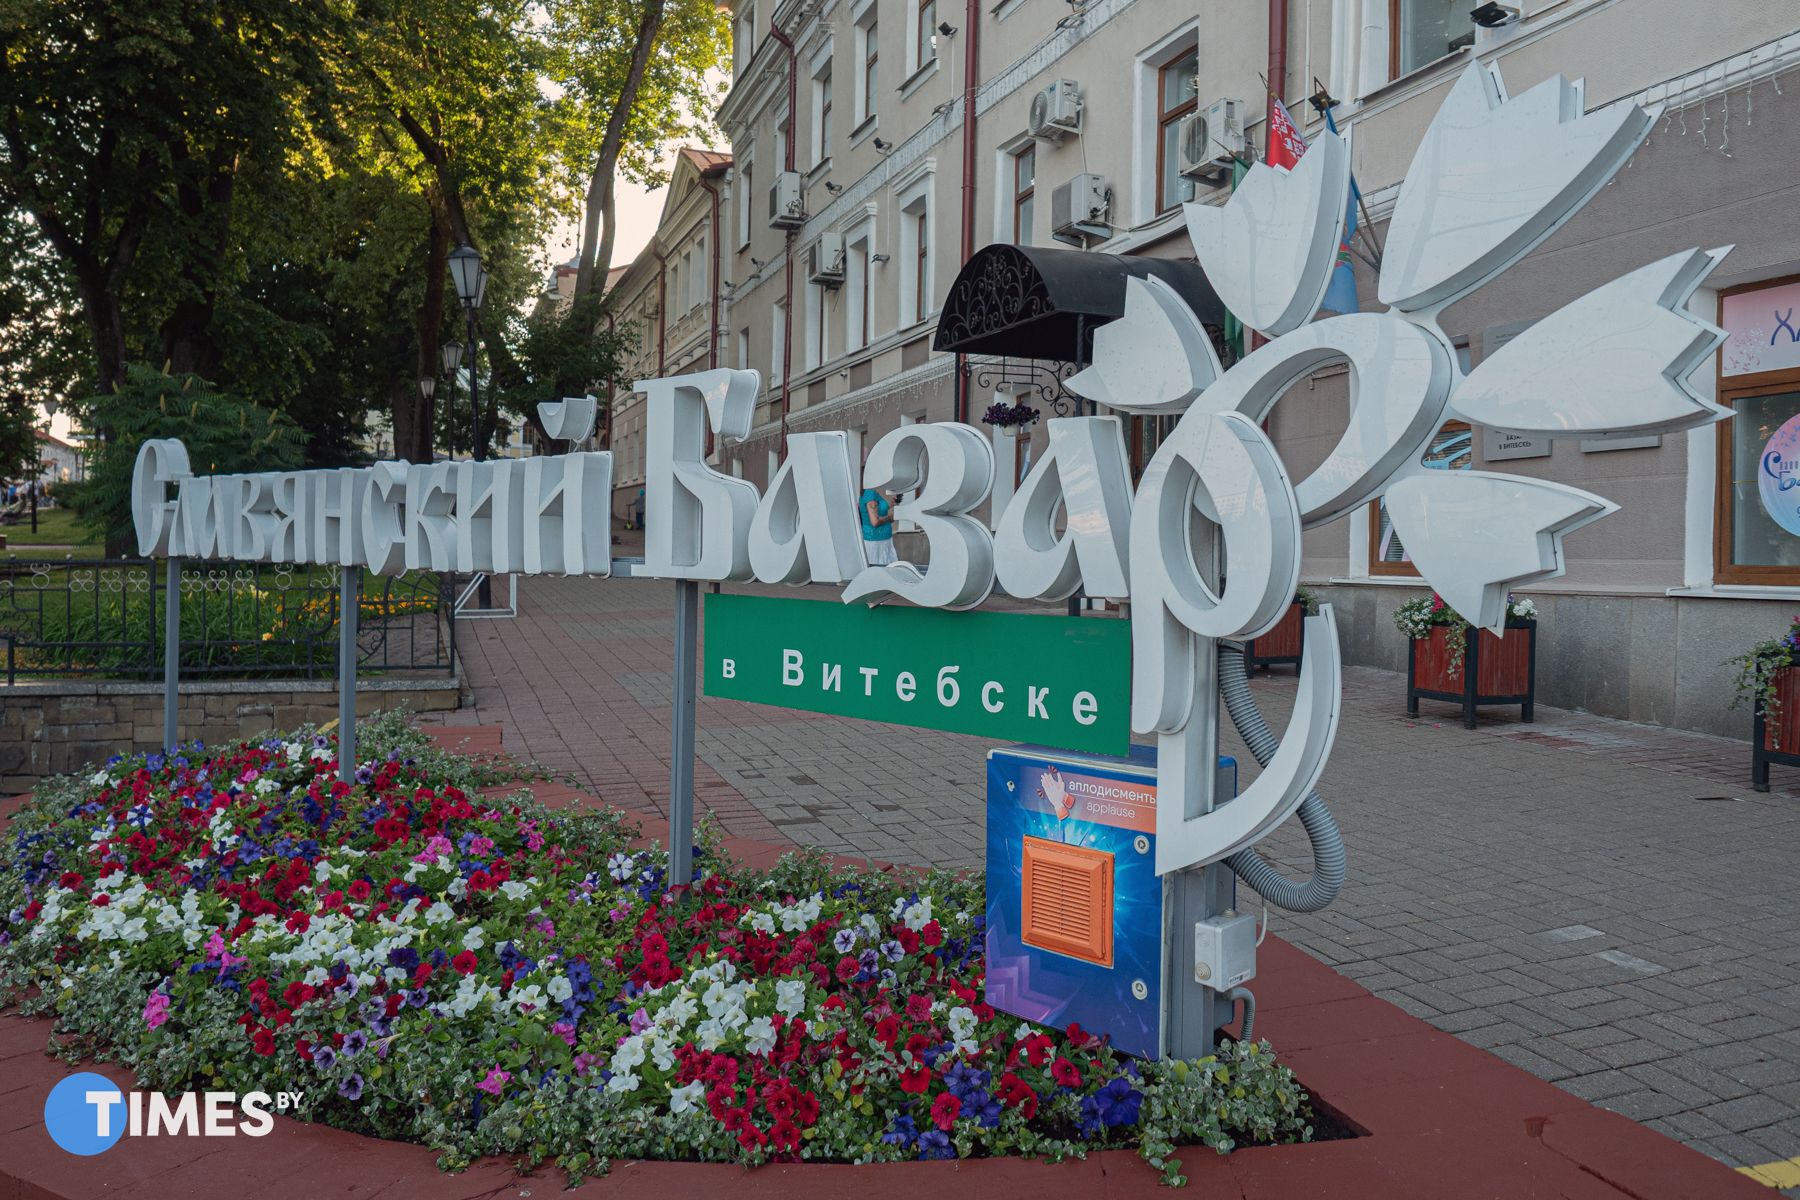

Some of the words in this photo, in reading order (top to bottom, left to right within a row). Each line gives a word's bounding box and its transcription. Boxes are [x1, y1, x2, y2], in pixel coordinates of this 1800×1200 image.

[722, 658, 736, 679] в
[782, 648, 1098, 726] Витебске
[1087, 801, 1136, 819] applause
